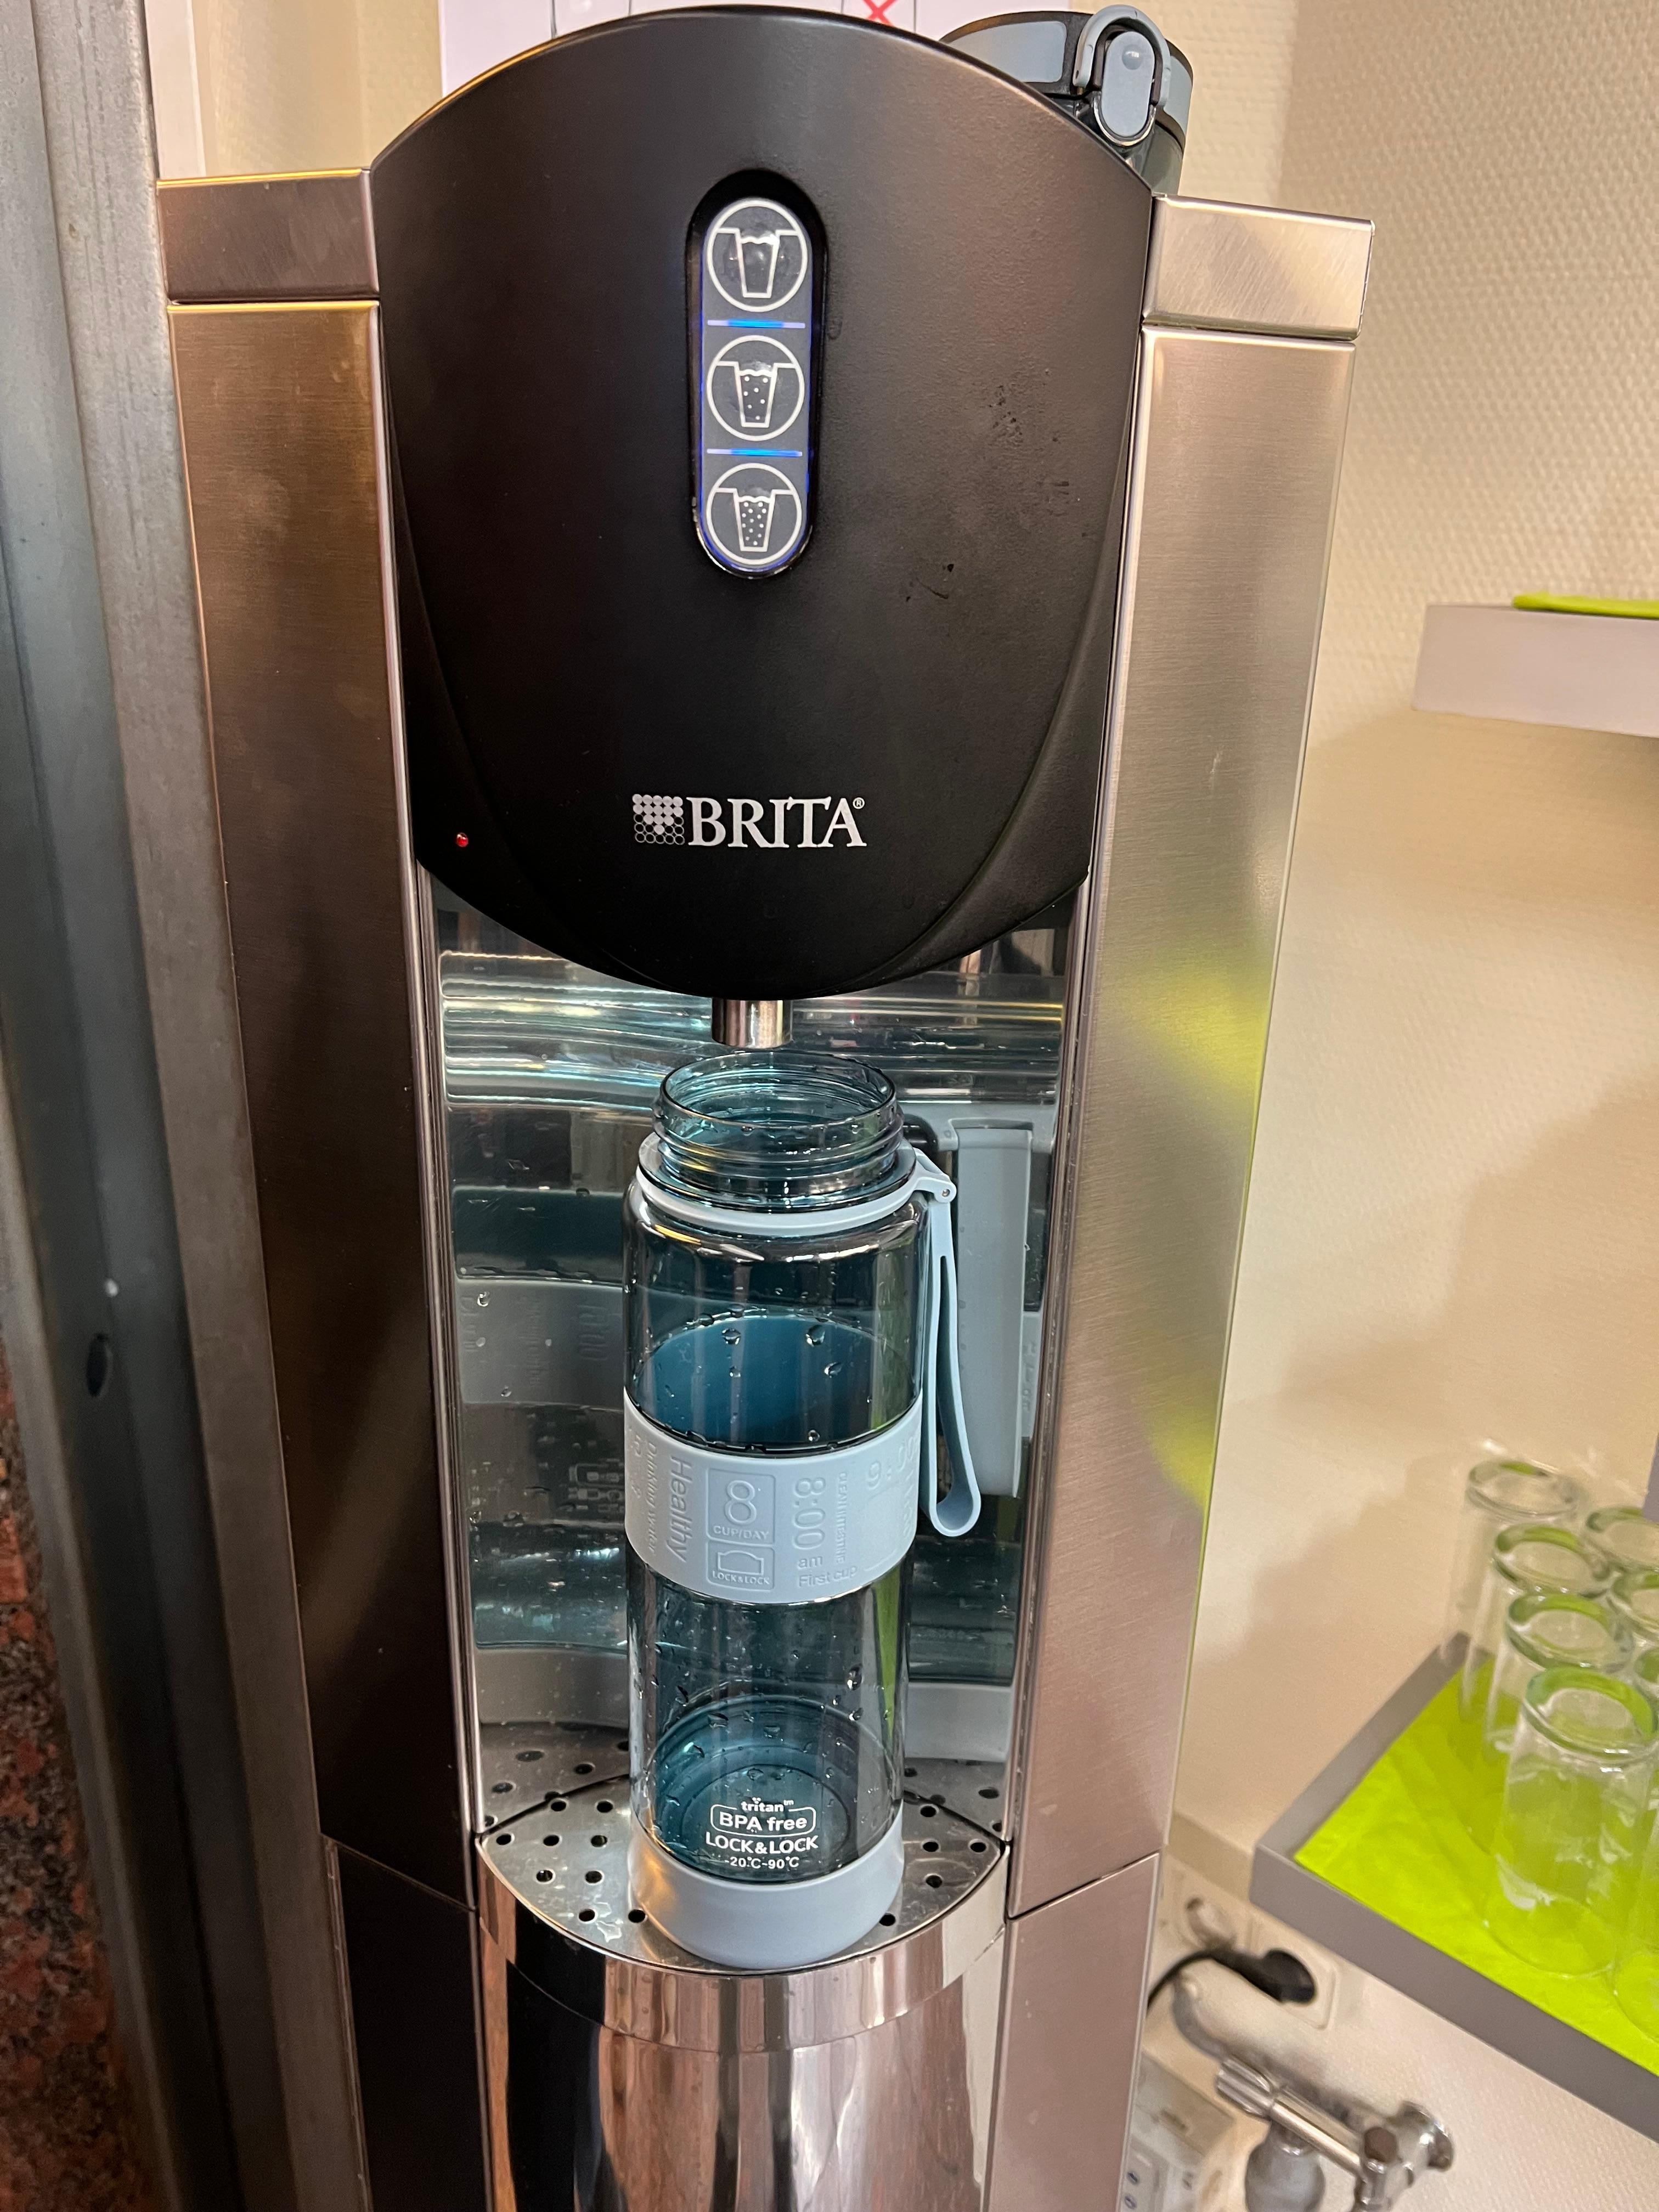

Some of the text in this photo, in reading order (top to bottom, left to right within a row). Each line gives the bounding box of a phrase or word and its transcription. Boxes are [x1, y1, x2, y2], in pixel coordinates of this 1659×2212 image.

[666, 1455, 693, 1563] Healthy
[793, 1477, 826, 1550] 8:00
[713, 1525, 769, 1540] CUP/DAY
[798, 1555, 823, 1570] am
[712, 1570, 770, 1585] LOCK&LOCK
[799, 1565, 858, 1588] First cup
[719, 1811, 808, 1831] BPA free
[706, 1831, 819, 1854] LOCK&LOCK
